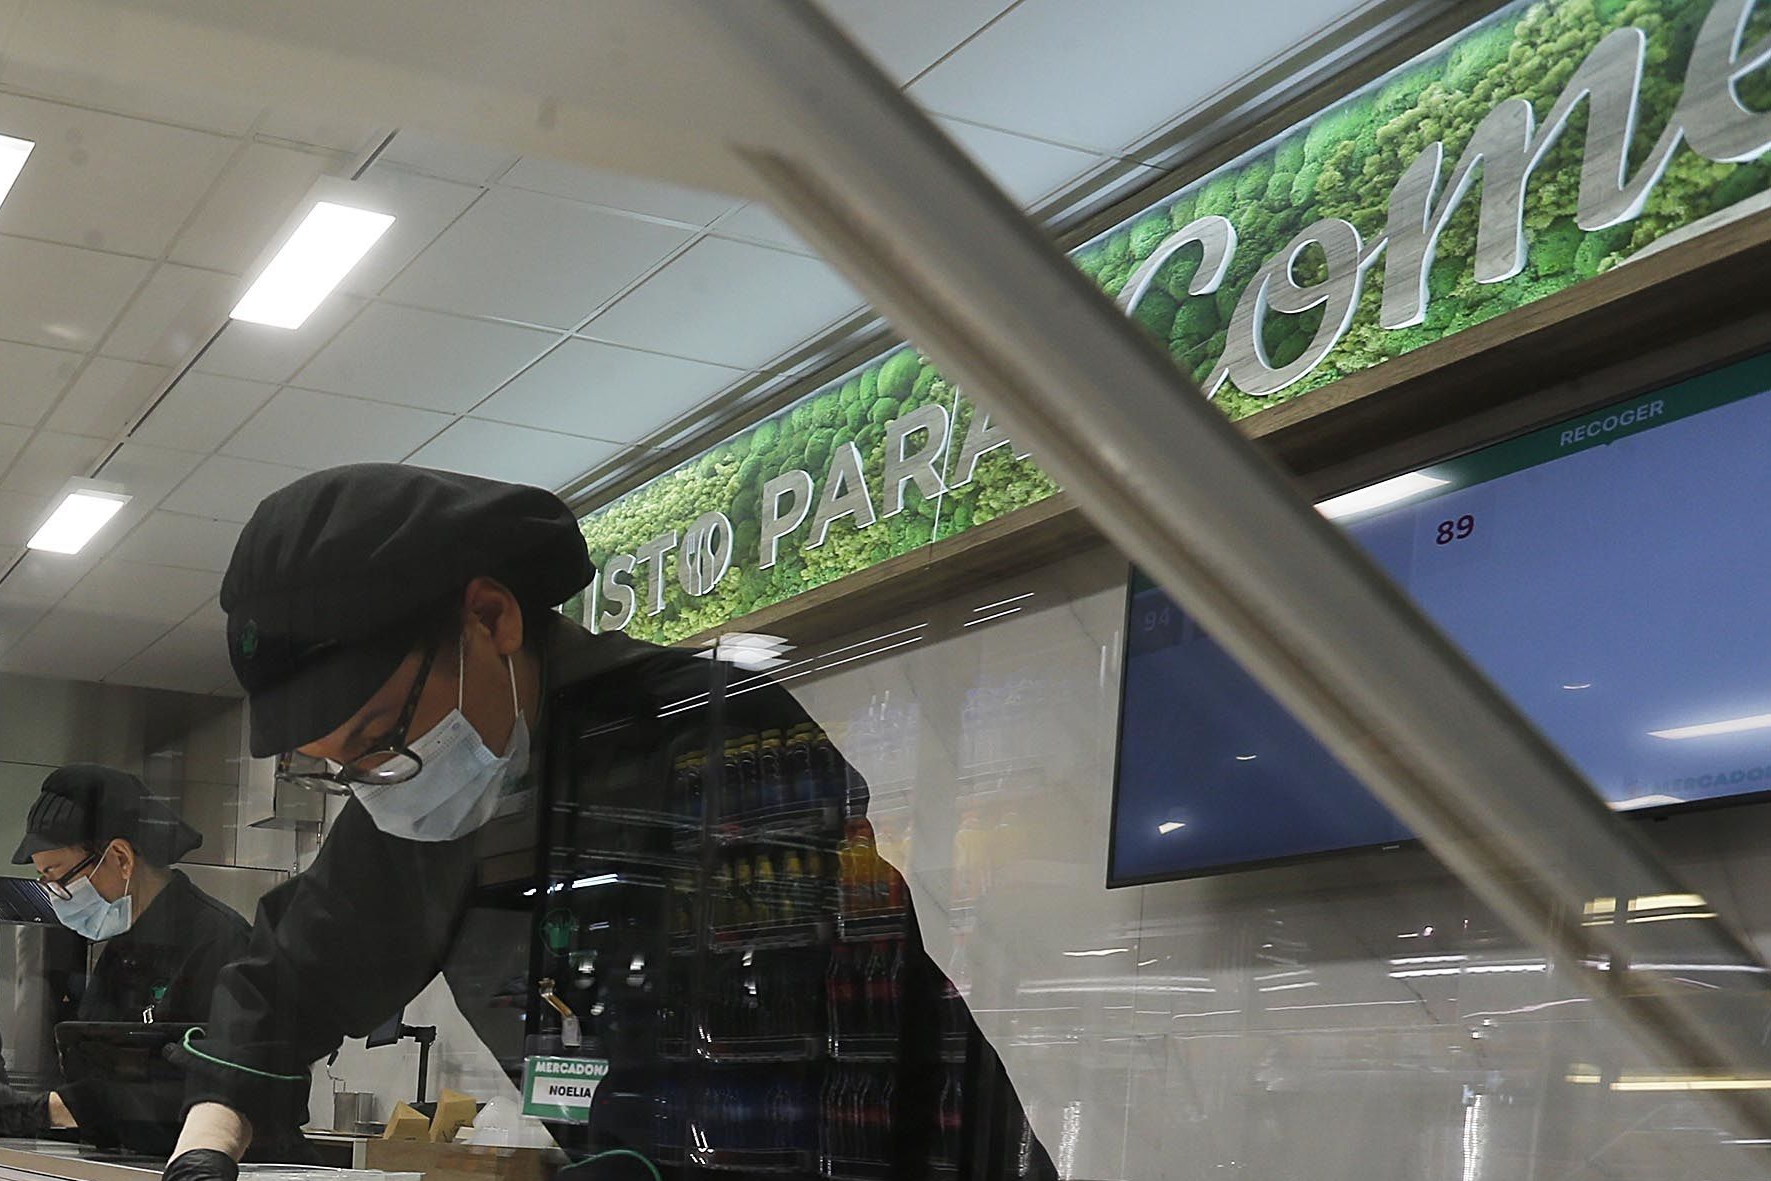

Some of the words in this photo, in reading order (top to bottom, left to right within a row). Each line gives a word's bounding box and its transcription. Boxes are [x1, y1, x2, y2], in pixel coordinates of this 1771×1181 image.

[1559, 400, 1665, 447] RECOGER
[1435, 514, 1474, 546] 89
[581, 511, 733, 634] ISTO
[548, 1085, 592, 1099] NOELIA
